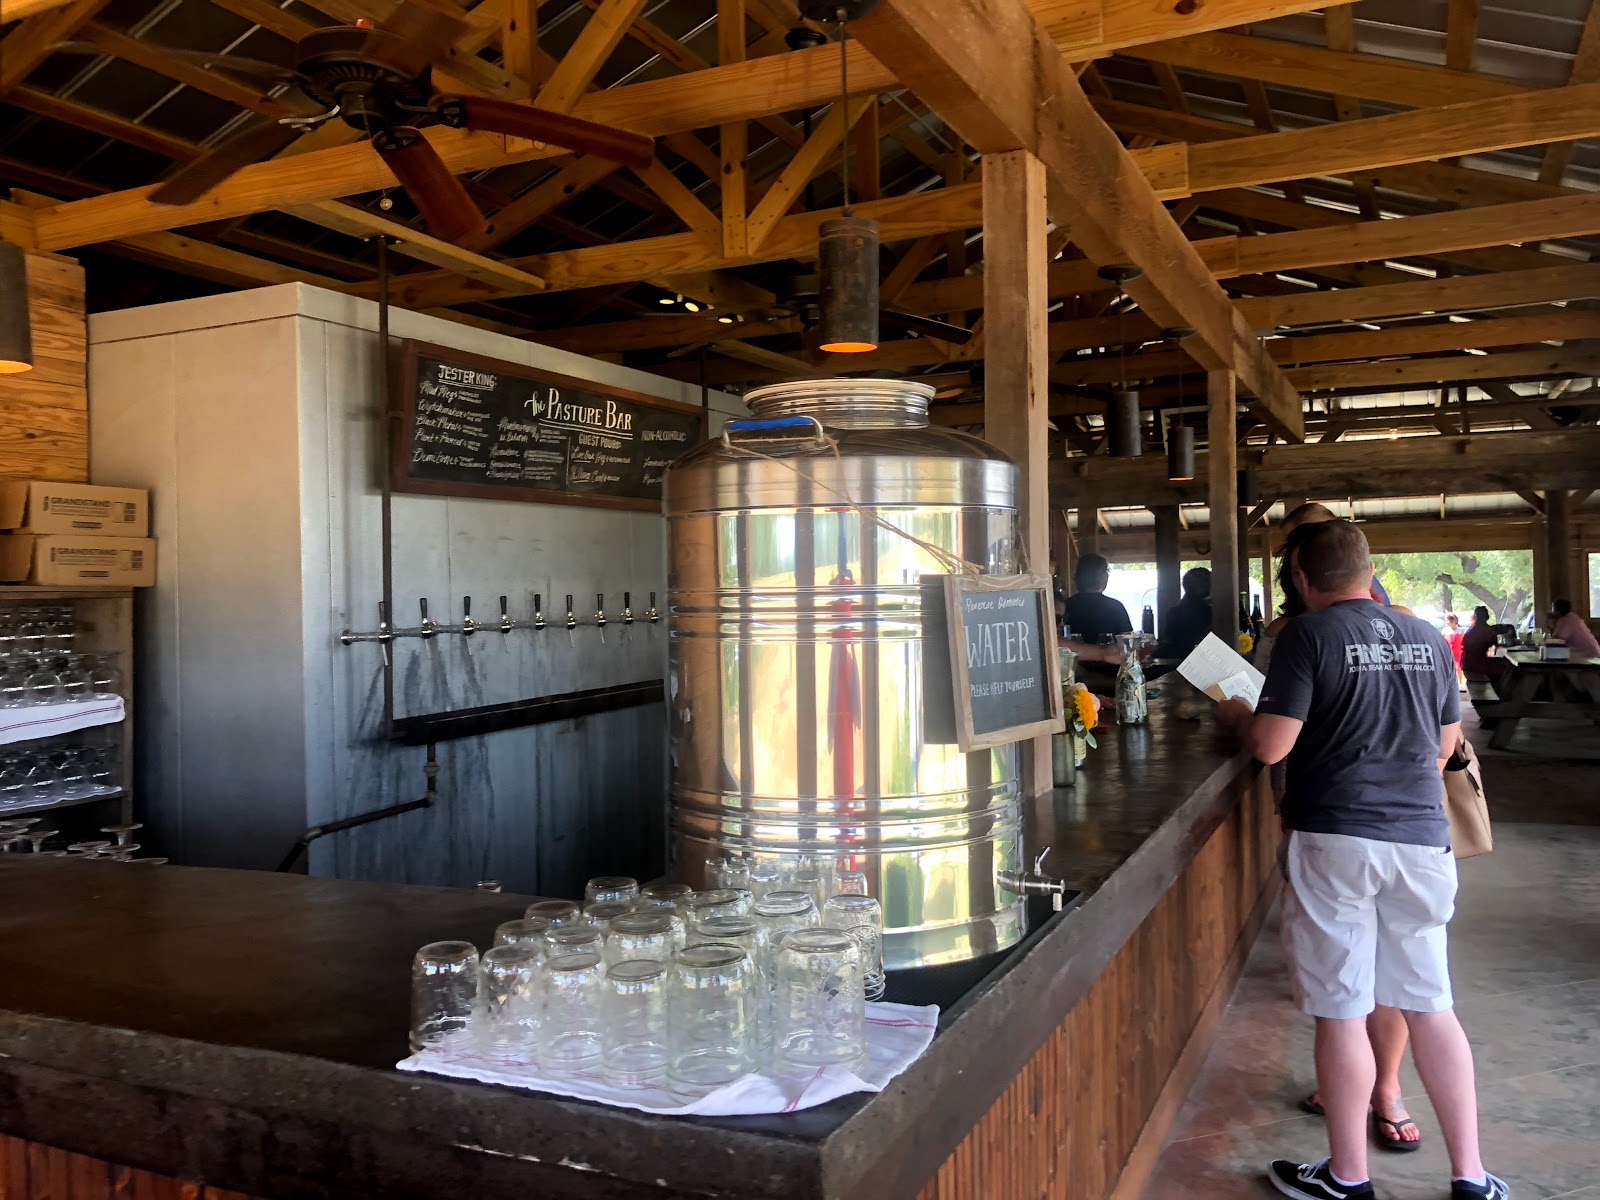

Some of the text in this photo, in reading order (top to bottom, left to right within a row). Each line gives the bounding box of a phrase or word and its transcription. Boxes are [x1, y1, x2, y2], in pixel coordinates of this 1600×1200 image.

[438, 364, 475, 385] JESTER
[578, 433, 600, 447] GUEST
[964, 597, 994, 613] Reverse
[964, 620, 1032, 669] WATER
[970, 684, 990, 697] PLEASE
[990, 681, 1003, 695] HELP
